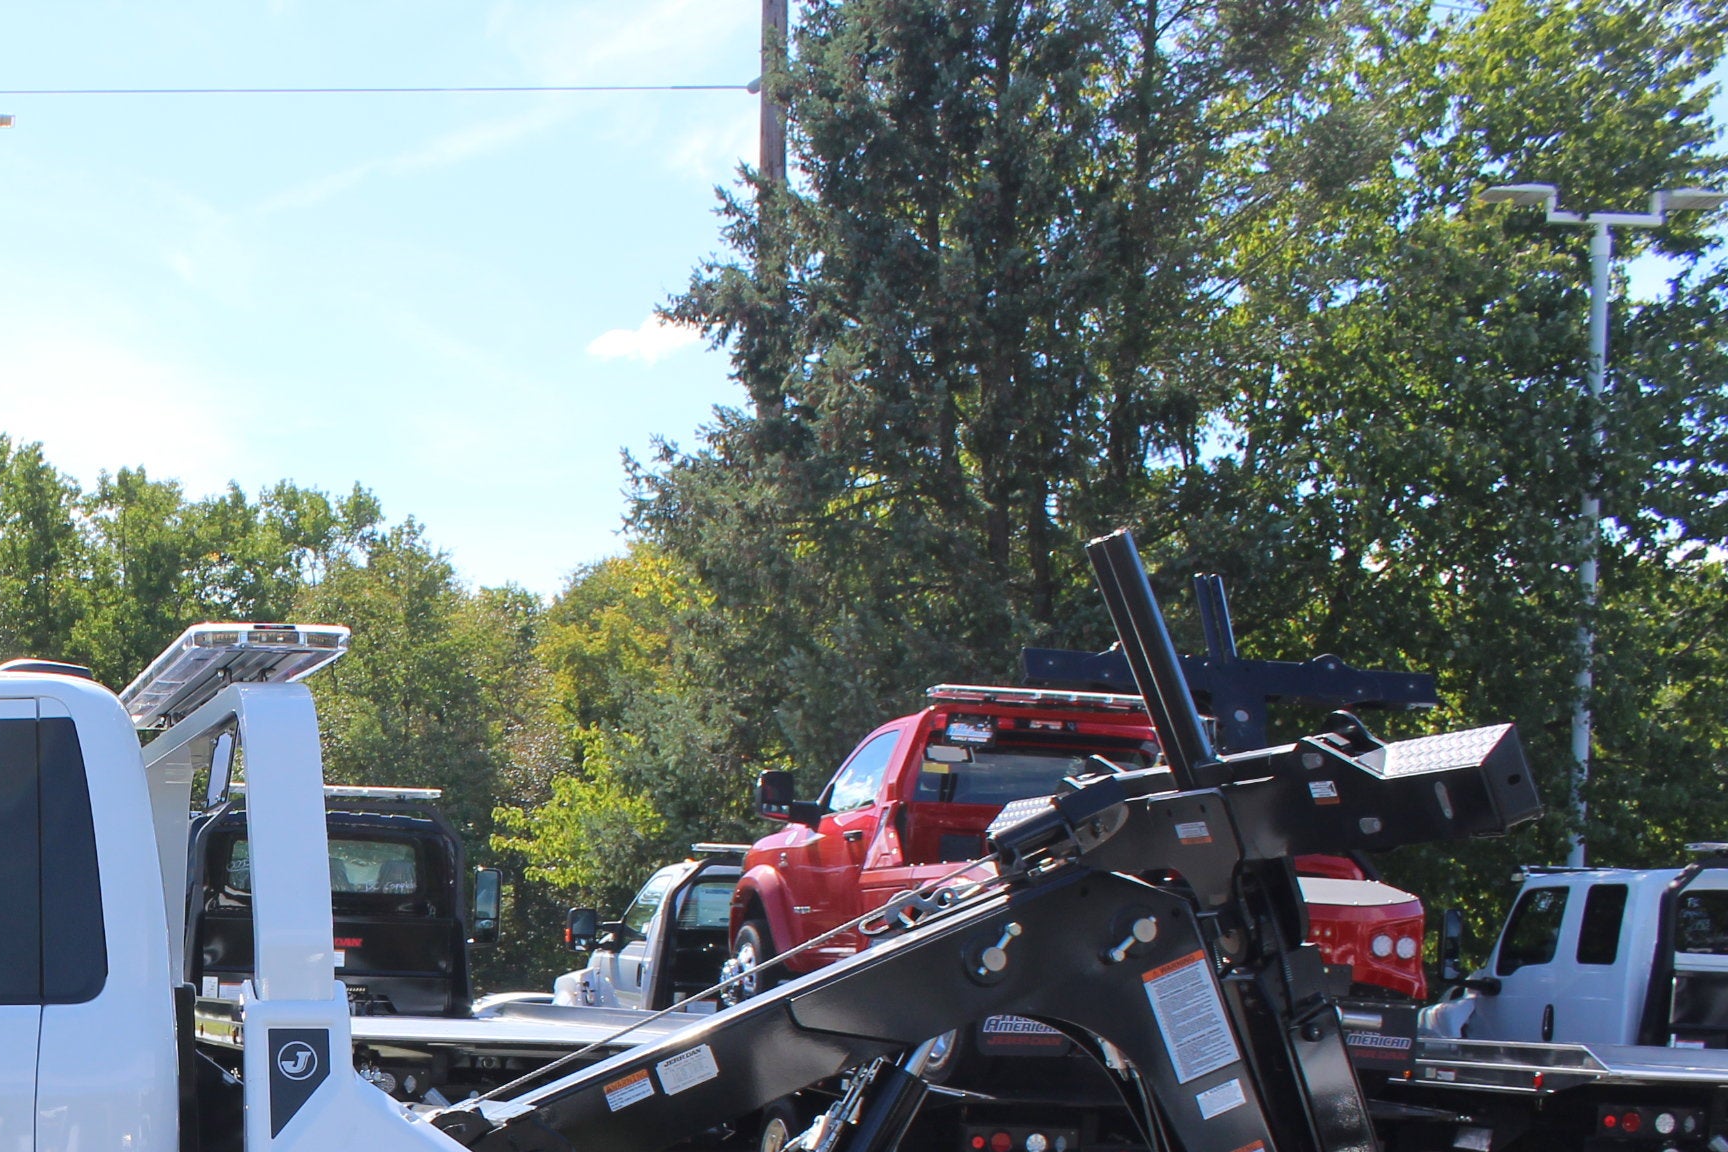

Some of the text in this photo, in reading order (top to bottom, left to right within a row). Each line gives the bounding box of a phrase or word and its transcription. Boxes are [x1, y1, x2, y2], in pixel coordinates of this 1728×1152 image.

[983, 1017, 1063, 1034] AMERICA
[1347, 1033, 1412, 1050] MERICAN
[615, 1070, 650, 1089] WARNING
